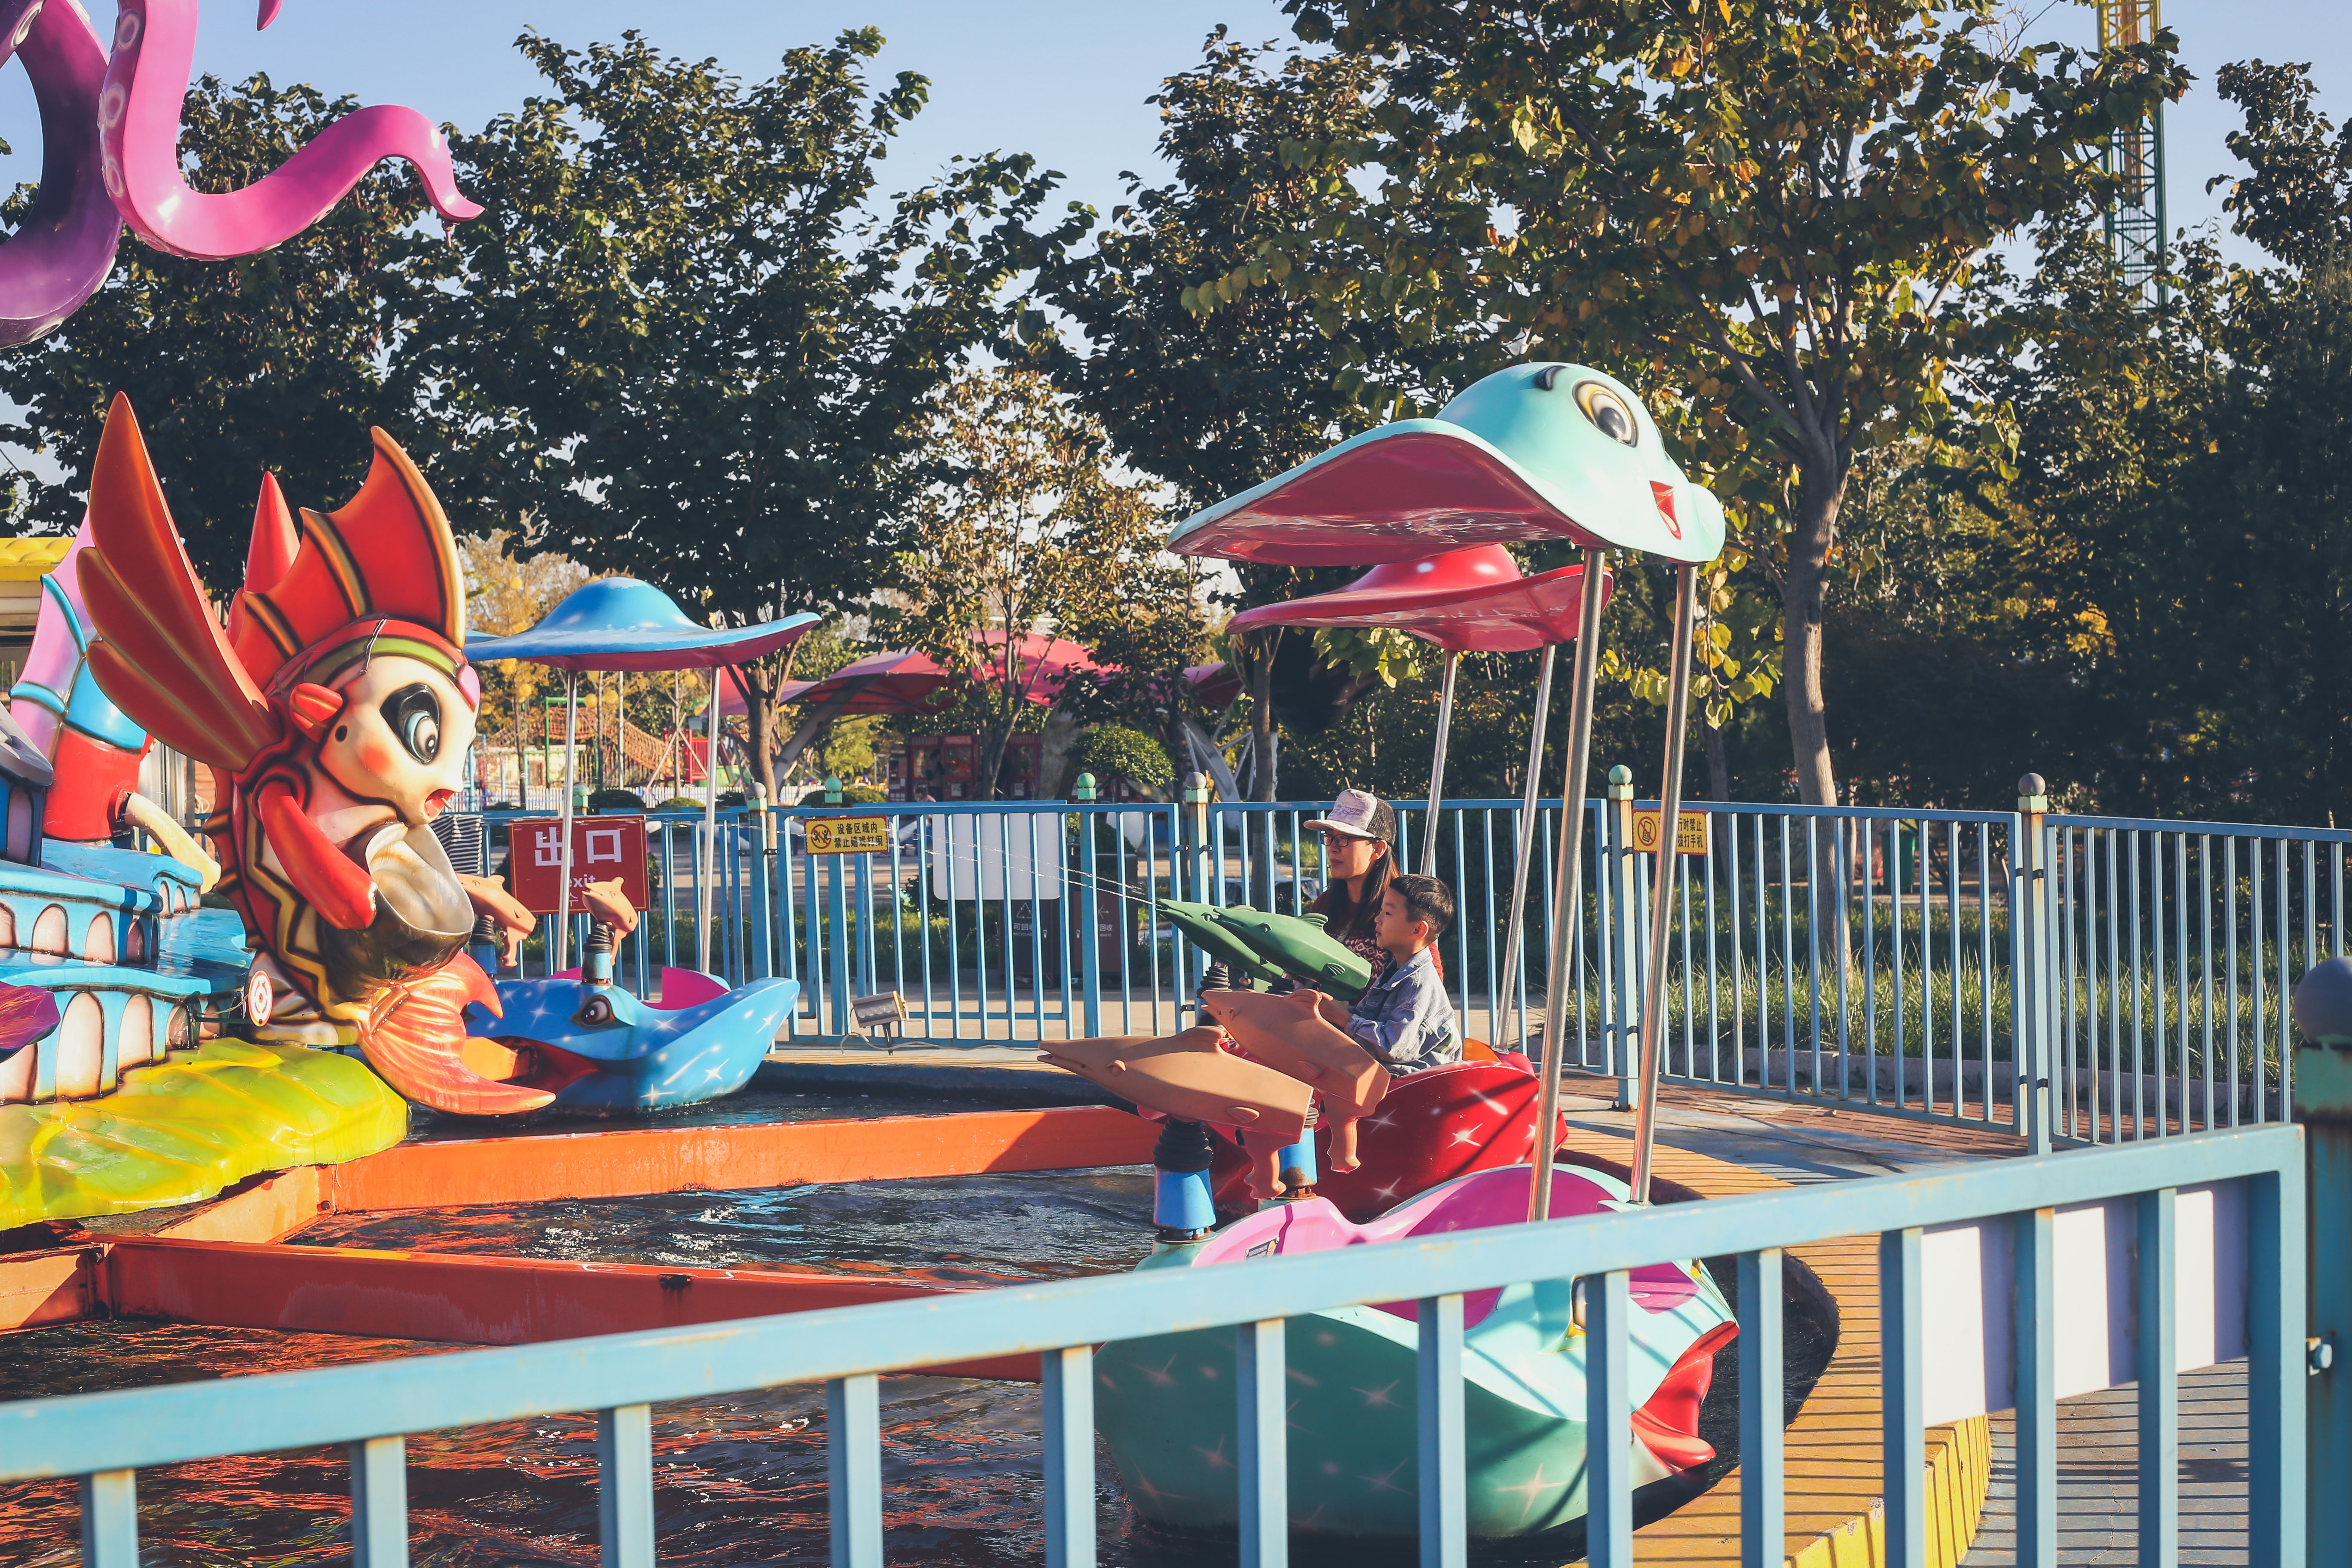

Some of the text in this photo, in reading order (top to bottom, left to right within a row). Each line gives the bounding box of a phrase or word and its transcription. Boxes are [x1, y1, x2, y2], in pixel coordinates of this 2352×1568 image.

[837, 821, 877, 834] 设备区域内
[535, 827, 622, 867] 出口
[834, 835, 883, 848] 禁止嬉戏打闹
